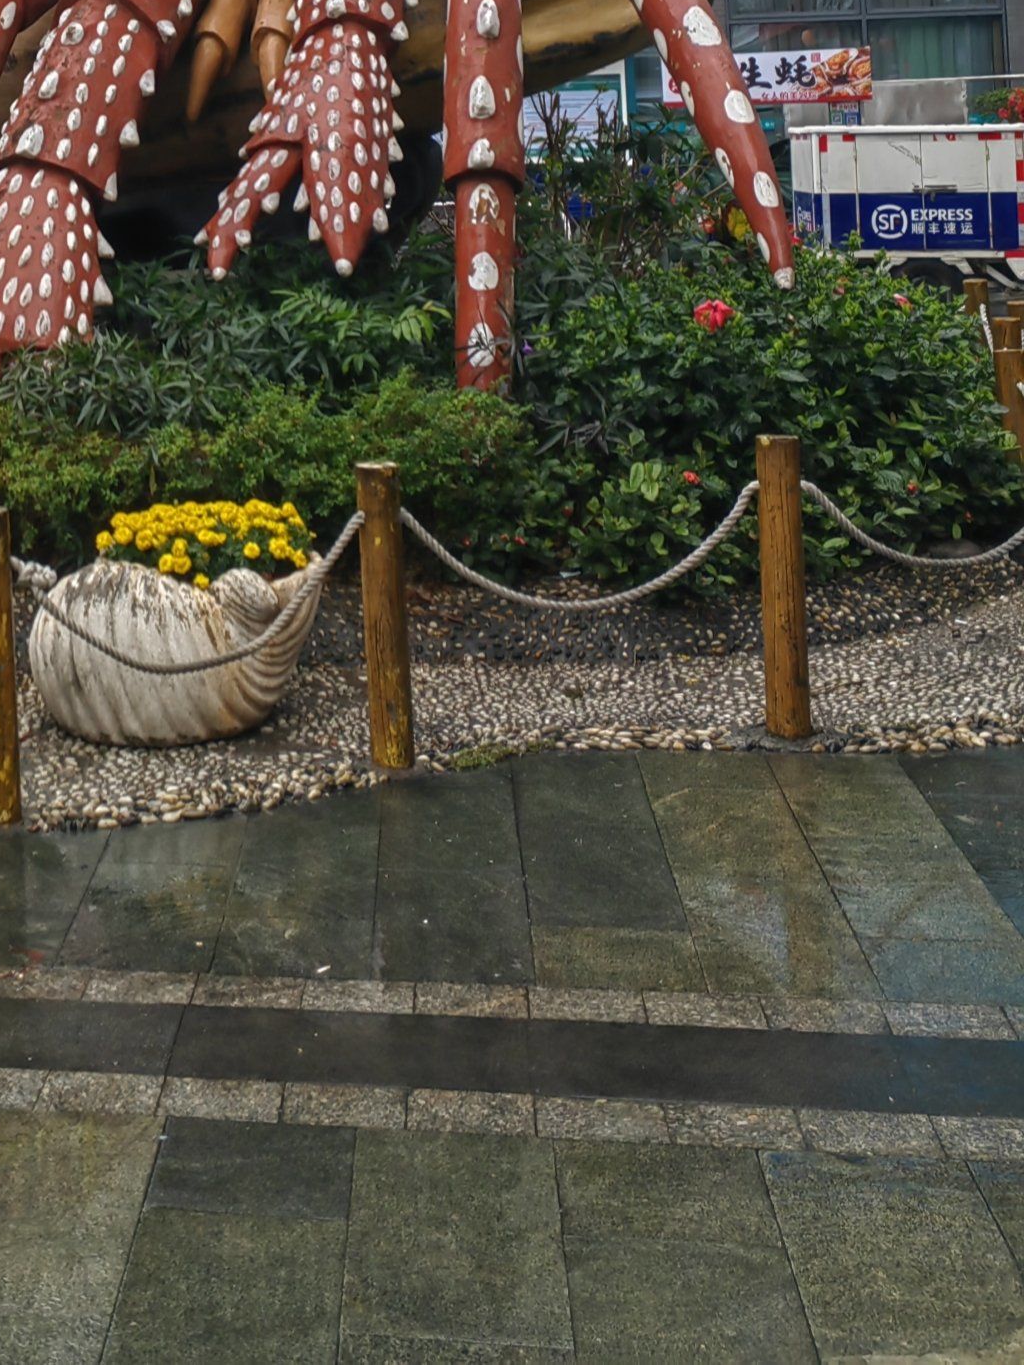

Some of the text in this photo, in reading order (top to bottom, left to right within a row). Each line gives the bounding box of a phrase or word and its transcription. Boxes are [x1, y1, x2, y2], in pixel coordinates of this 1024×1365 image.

[740, 55, 817, 90] 生蚝
[910, 208, 974, 221] EXPRESS
[910, 222, 974, 234] 顺丰速运
